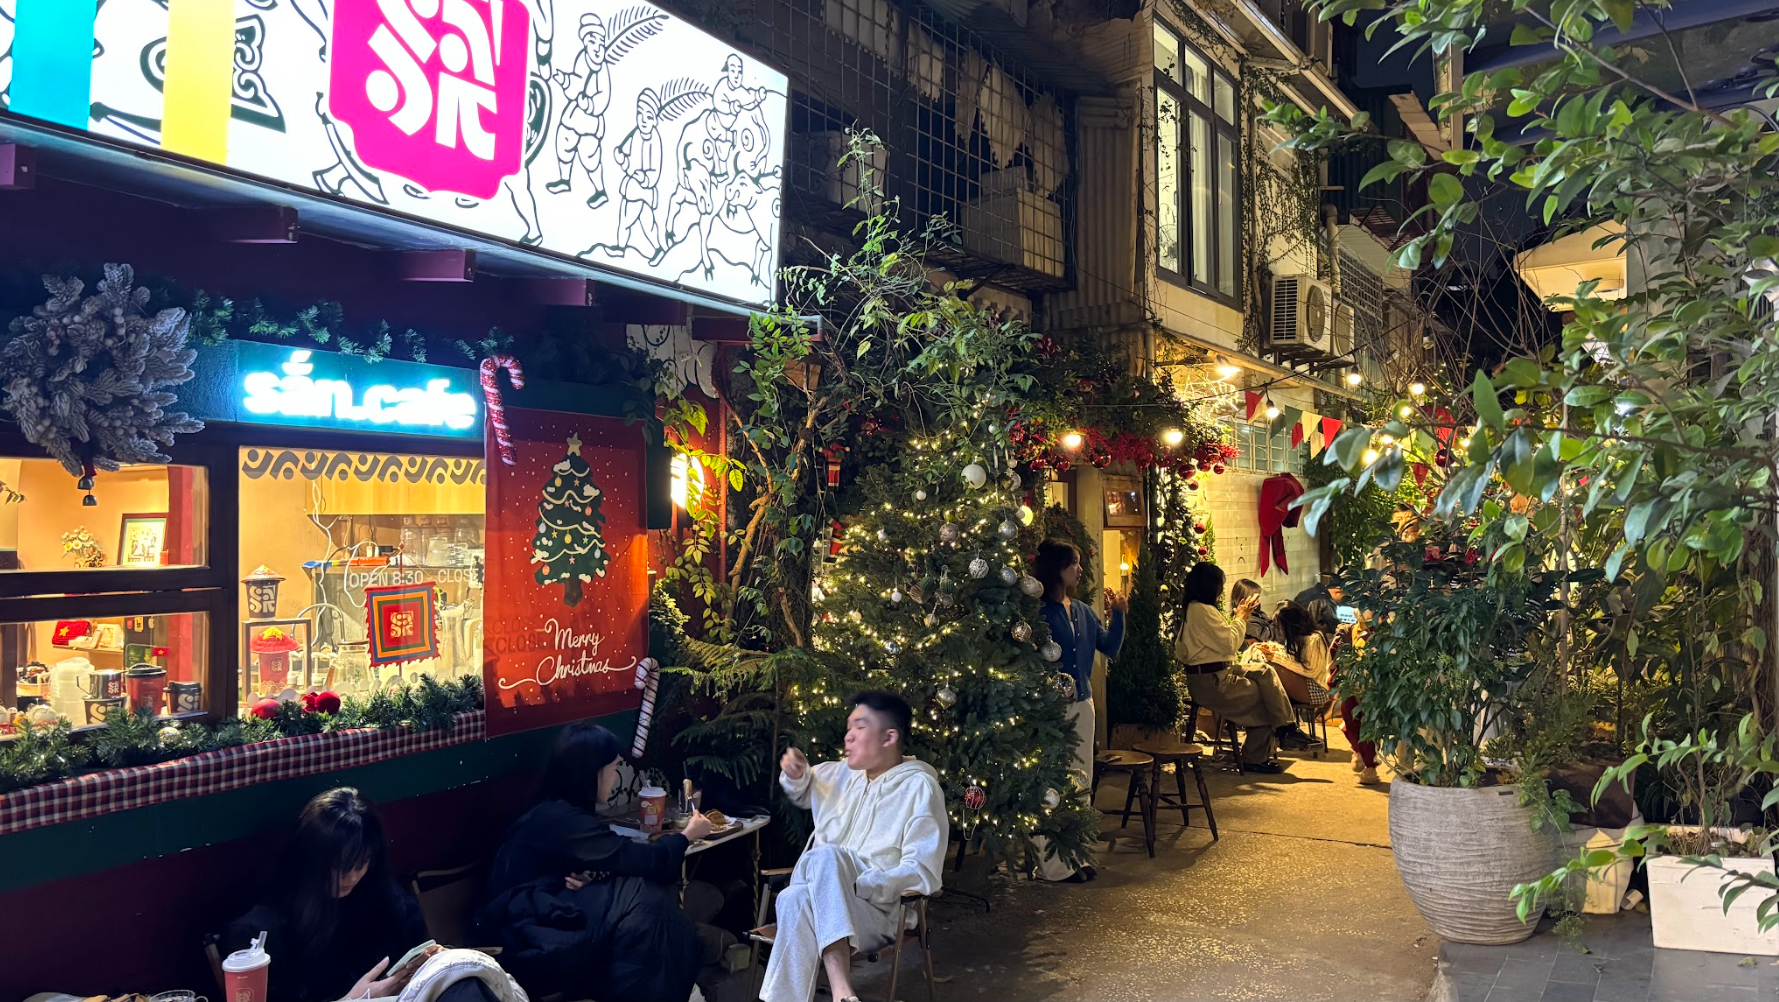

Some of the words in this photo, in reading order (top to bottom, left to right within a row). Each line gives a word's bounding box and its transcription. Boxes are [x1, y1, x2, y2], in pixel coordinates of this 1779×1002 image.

[349, 572, 388, 588] OPEN
[392, 570, 424, 584] 8:30
[544, 618, 605, 656] Merry
[536, 650, 636, 686] Christmas
